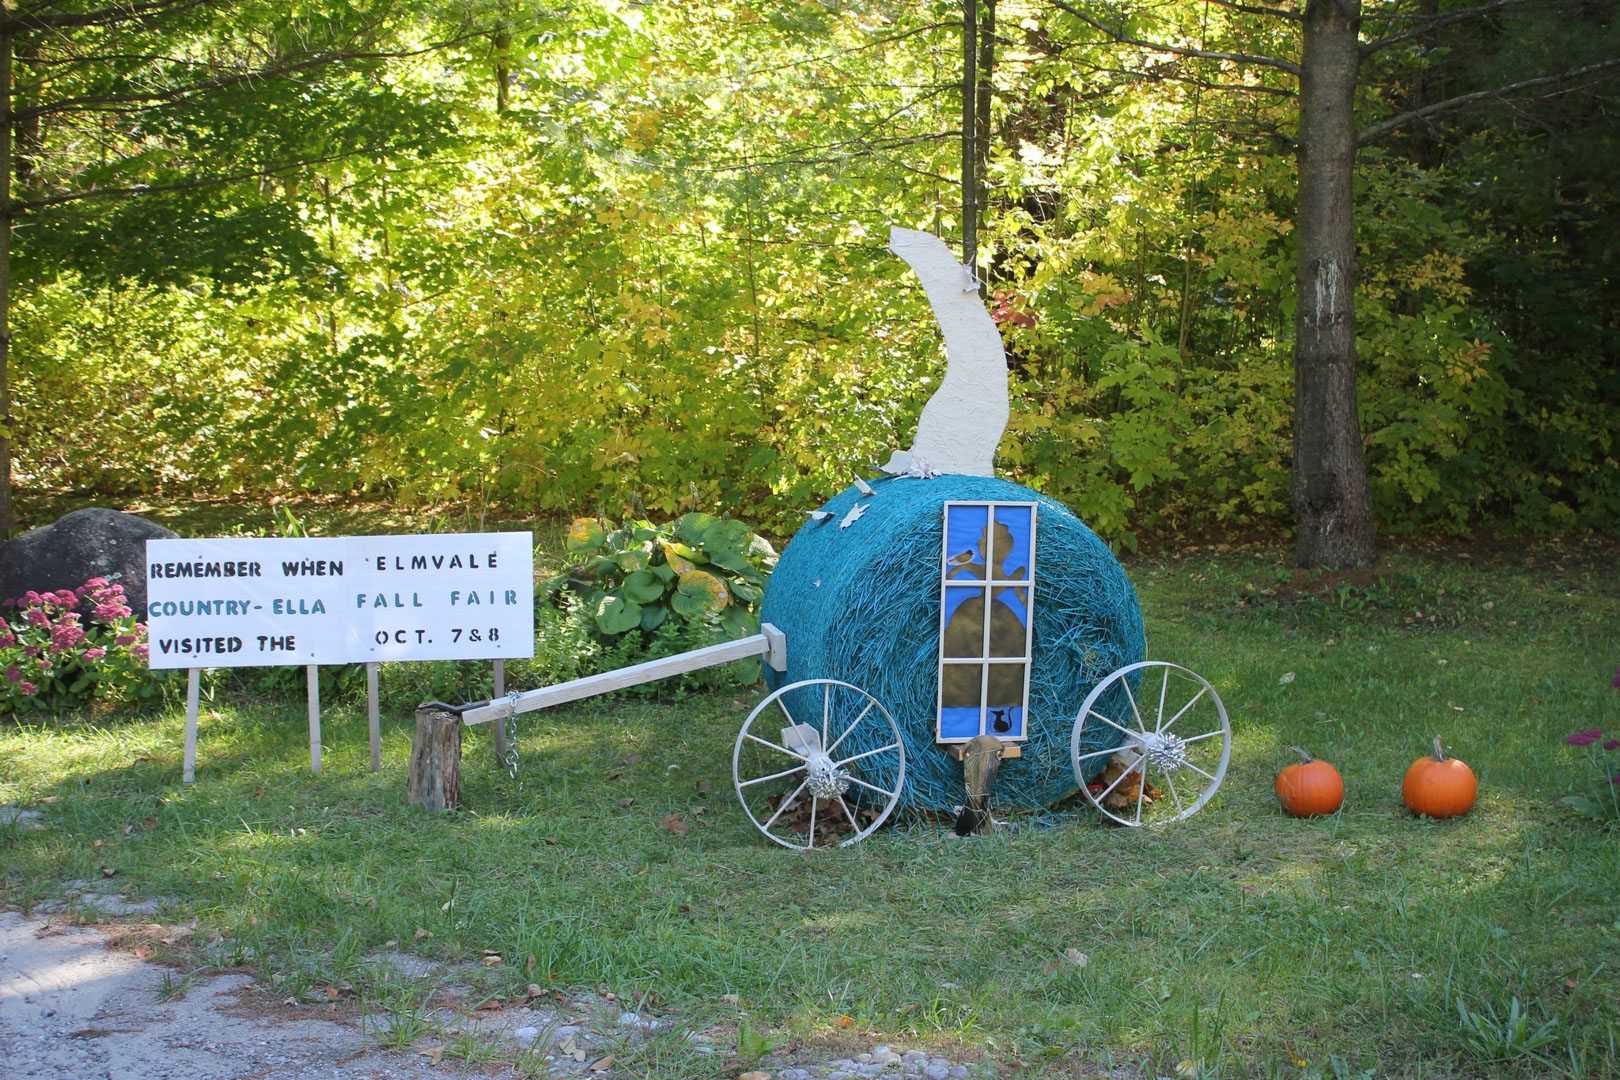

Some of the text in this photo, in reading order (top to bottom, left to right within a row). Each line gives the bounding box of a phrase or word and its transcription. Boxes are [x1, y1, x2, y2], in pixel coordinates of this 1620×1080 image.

[150, 560, 344, 579] REMEMBER WHEN
[376, 553, 498, 571] ELMVALE
[272, 598, 326, 615] ELLA
[356, 589, 518, 609] FALL FAIR
[158, 635, 296, 655] VISITED THE
[374, 629, 434, 645] OCT.
